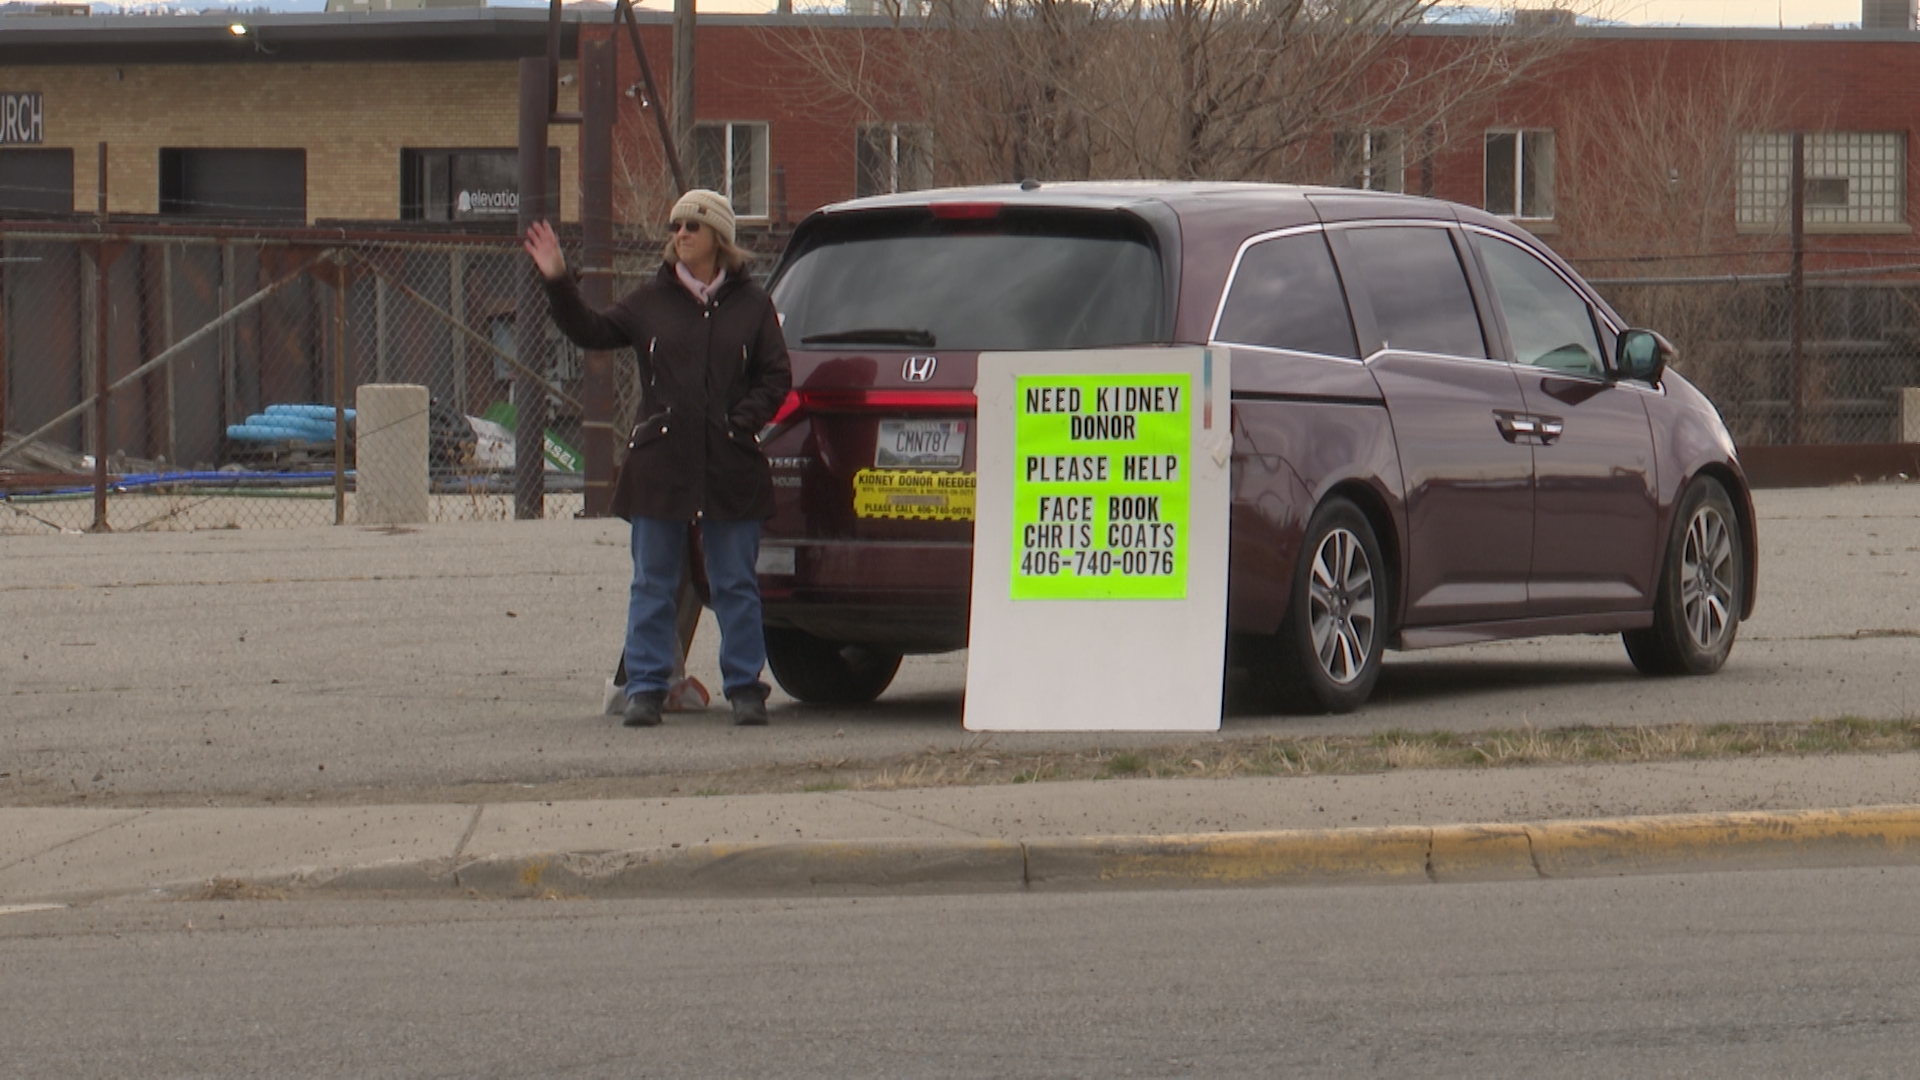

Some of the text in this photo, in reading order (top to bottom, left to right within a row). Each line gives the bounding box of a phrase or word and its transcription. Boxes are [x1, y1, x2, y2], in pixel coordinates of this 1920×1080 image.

[1026, 387, 1180, 413] NEED KIDNEY
[1071, 415, 1136, 440] DONOR
[896, 431, 950, 452] CMN787
[1026, 455, 1177, 481] PLEASE HELP
[859, 475, 976, 488] KIDNEY DONOR NEEDED
[865, 503, 892, 513] PLEASE
[895, 504, 914, 514] CALL
[1040, 496, 1159, 521] FACE BOOK
[1024, 523, 1175, 549] CHRIS COATS
[1021, 551, 1174, 576] 406-740-0076
